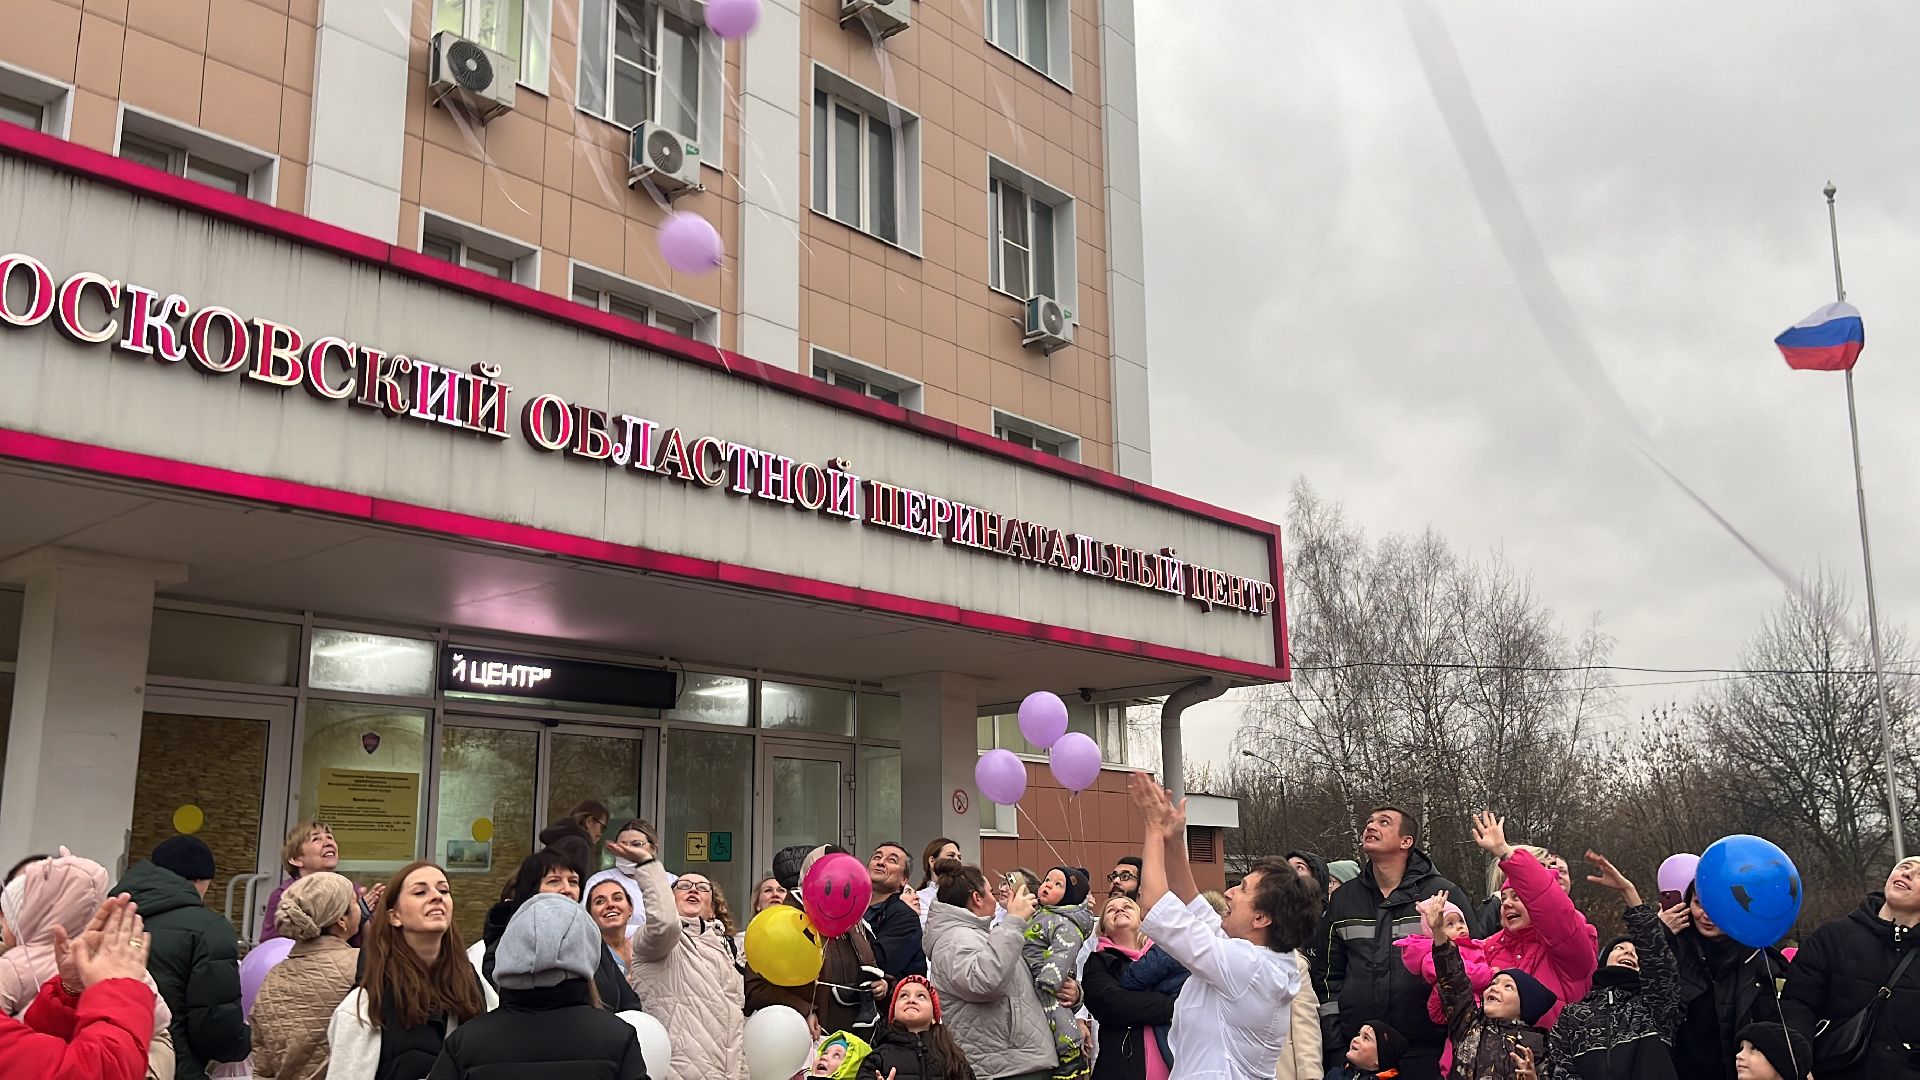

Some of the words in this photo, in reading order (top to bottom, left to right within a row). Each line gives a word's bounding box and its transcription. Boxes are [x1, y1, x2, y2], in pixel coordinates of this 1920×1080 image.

[526, 393, 861, 520] ОБЛАСТНОЙ
[869, 479, 1186, 596] ПЕРИНАТАЛЬНЫЙ
[1189, 563, 1276, 615] ЦЕНТР
